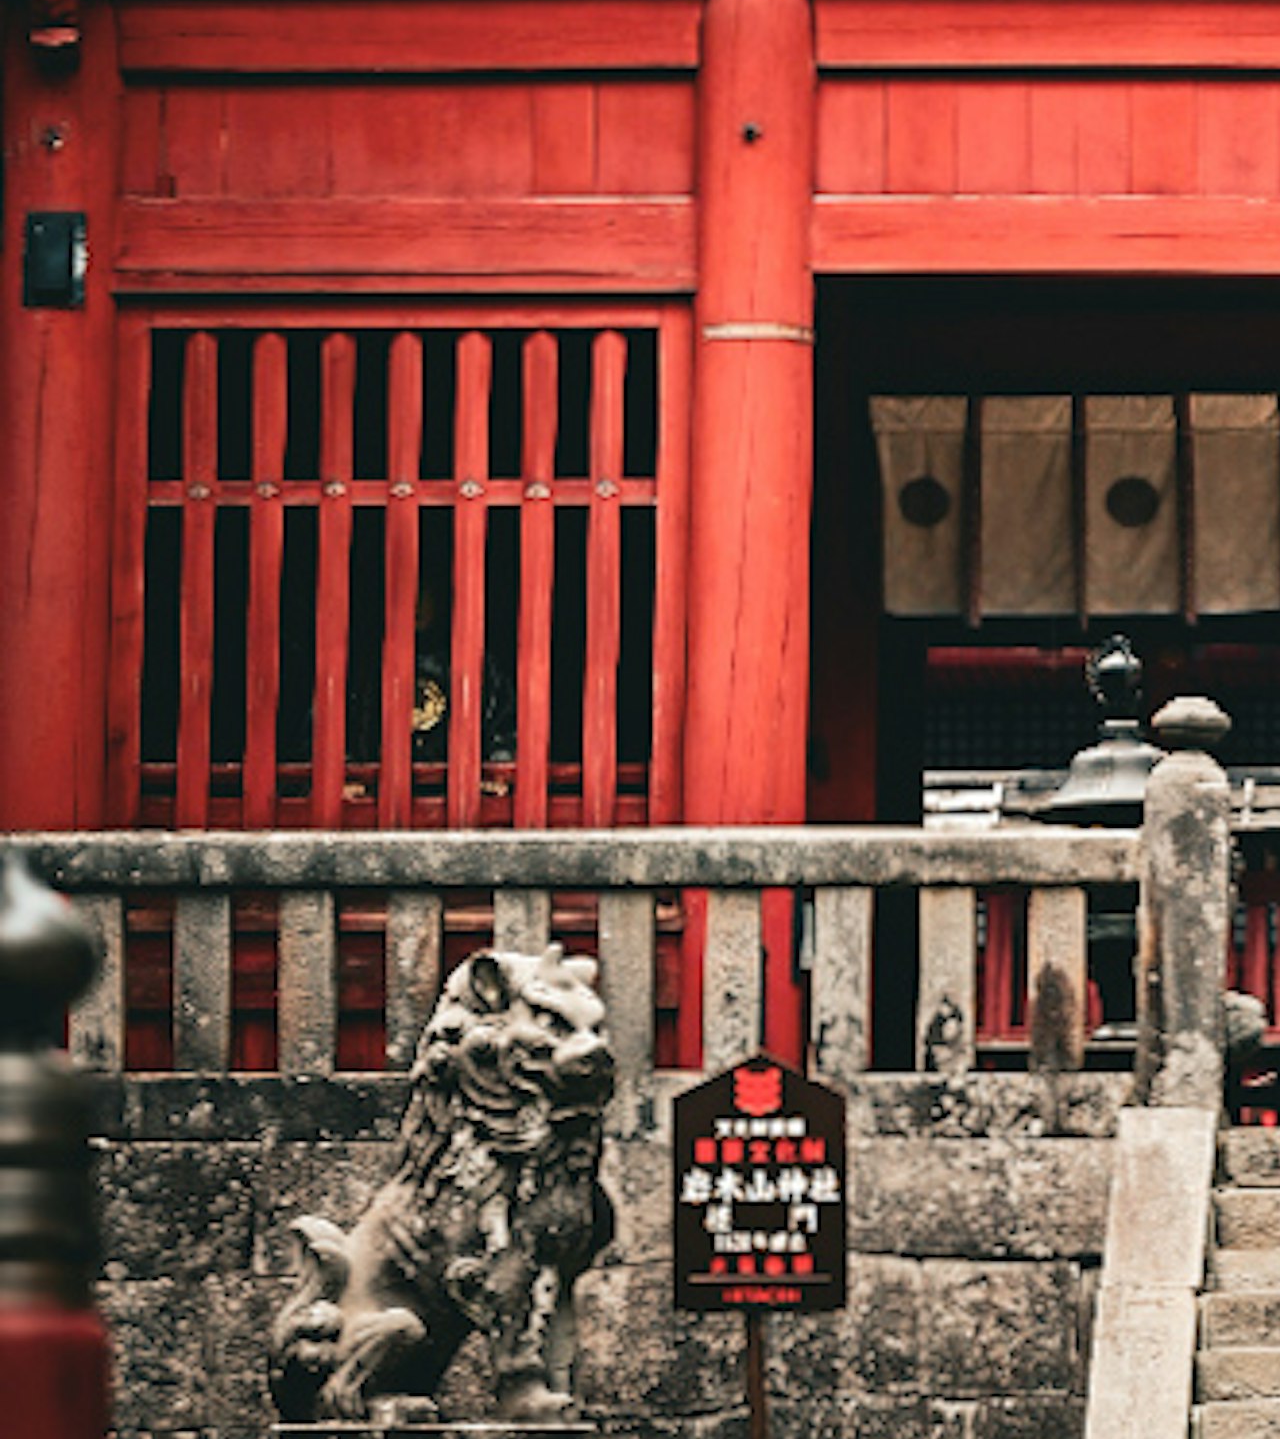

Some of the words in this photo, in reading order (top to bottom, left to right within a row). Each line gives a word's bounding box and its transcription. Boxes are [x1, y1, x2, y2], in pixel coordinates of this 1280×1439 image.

[694, 1137, 826, 1164] 文化財
[680, 1167, 841, 1205] 岩木山神社
